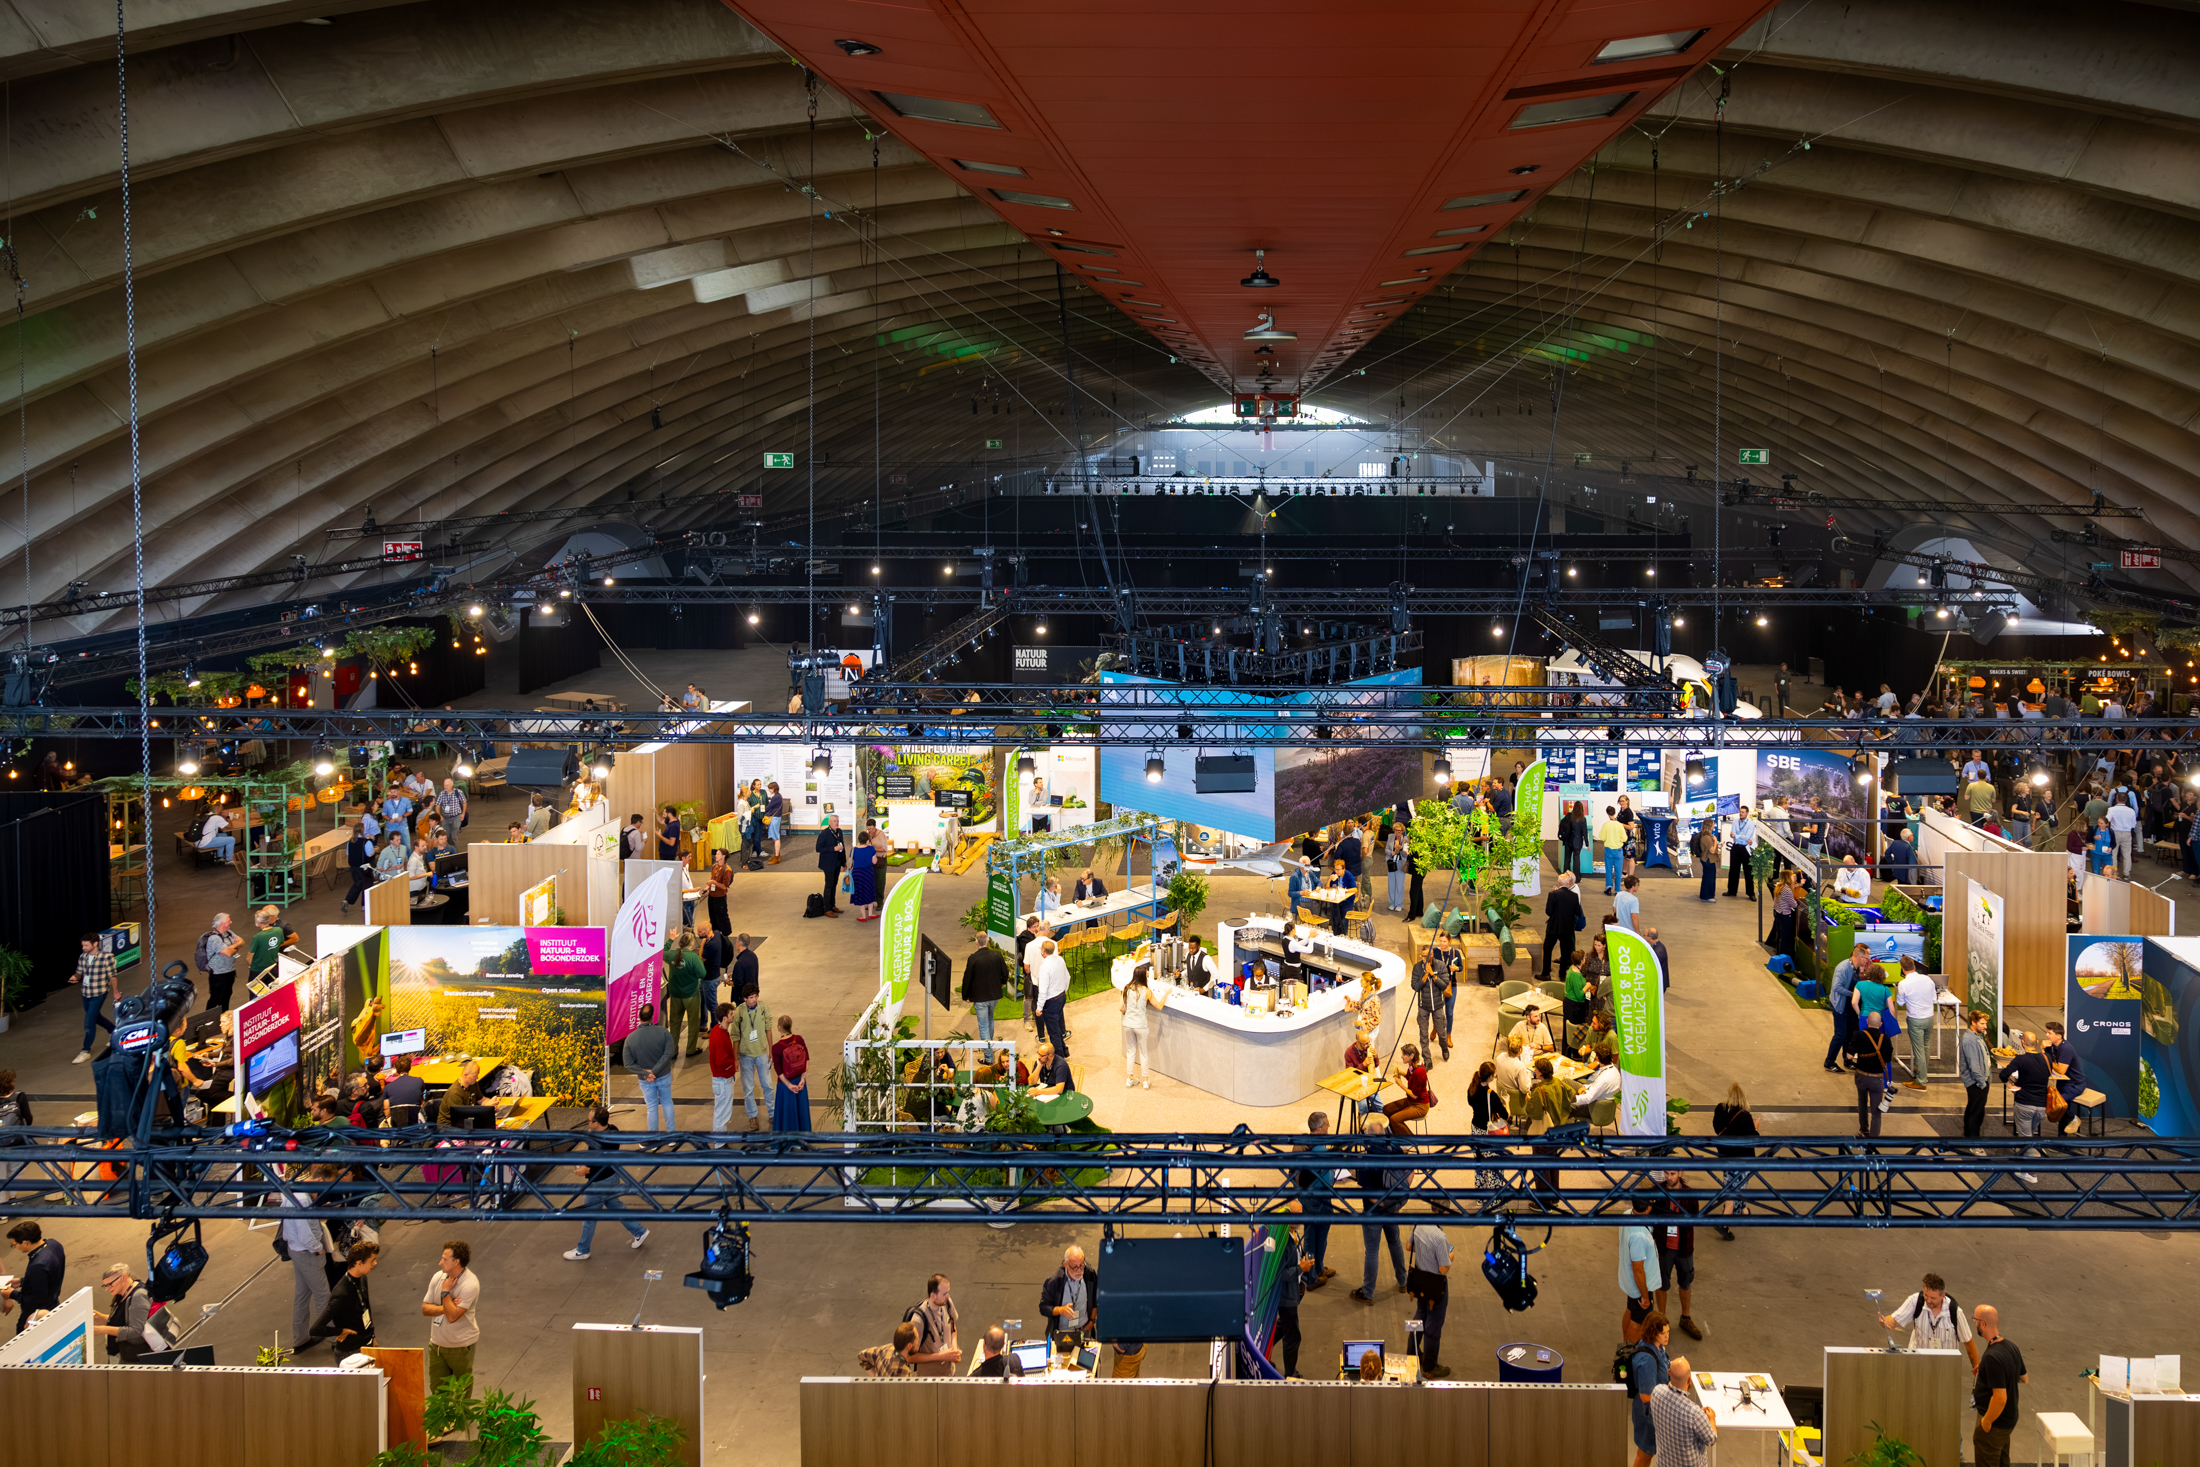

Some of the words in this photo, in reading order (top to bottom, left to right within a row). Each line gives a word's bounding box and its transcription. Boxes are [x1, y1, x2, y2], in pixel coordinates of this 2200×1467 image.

[1015, 649, 1047, 658] NATUUR
[1015, 658, 1047, 668] FUTUUR
[2088, 669, 2105, 678] POKÉ
[2107, 670, 2130, 678] BOWLS
[901, 745, 969, 753] WILDFLOWER
[897, 754, 931, 765] LIVING
[933, 754, 972, 766] CARPET
[1766, 754, 1801, 770] SBE
[1532, 772, 1541, 791] BOS
[1532, 793, 1538, 801] &
[904, 898, 914, 922] BOS
[904, 924, 913, 932] &
[540, 939, 577, 947] INSTITUUT
[893, 913, 903, 983] AGENTSCHAP
[902, 934, 913, 982] NATUUR
[639, 977, 646, 989] EN
[645, 961, 654, 1004] NDERZOEK
[629, 990, 637, 1031] INSTITUUT
[242, 1006, 272, 1030] INSTITUUT
[243, 1018, 271, 1038] NATUUR-
[270, 1011, 280, 1021] EN
[126, 1028, 149, 1040] CM
[243, 1014, 290, 1048] BOSONDERZOEK
